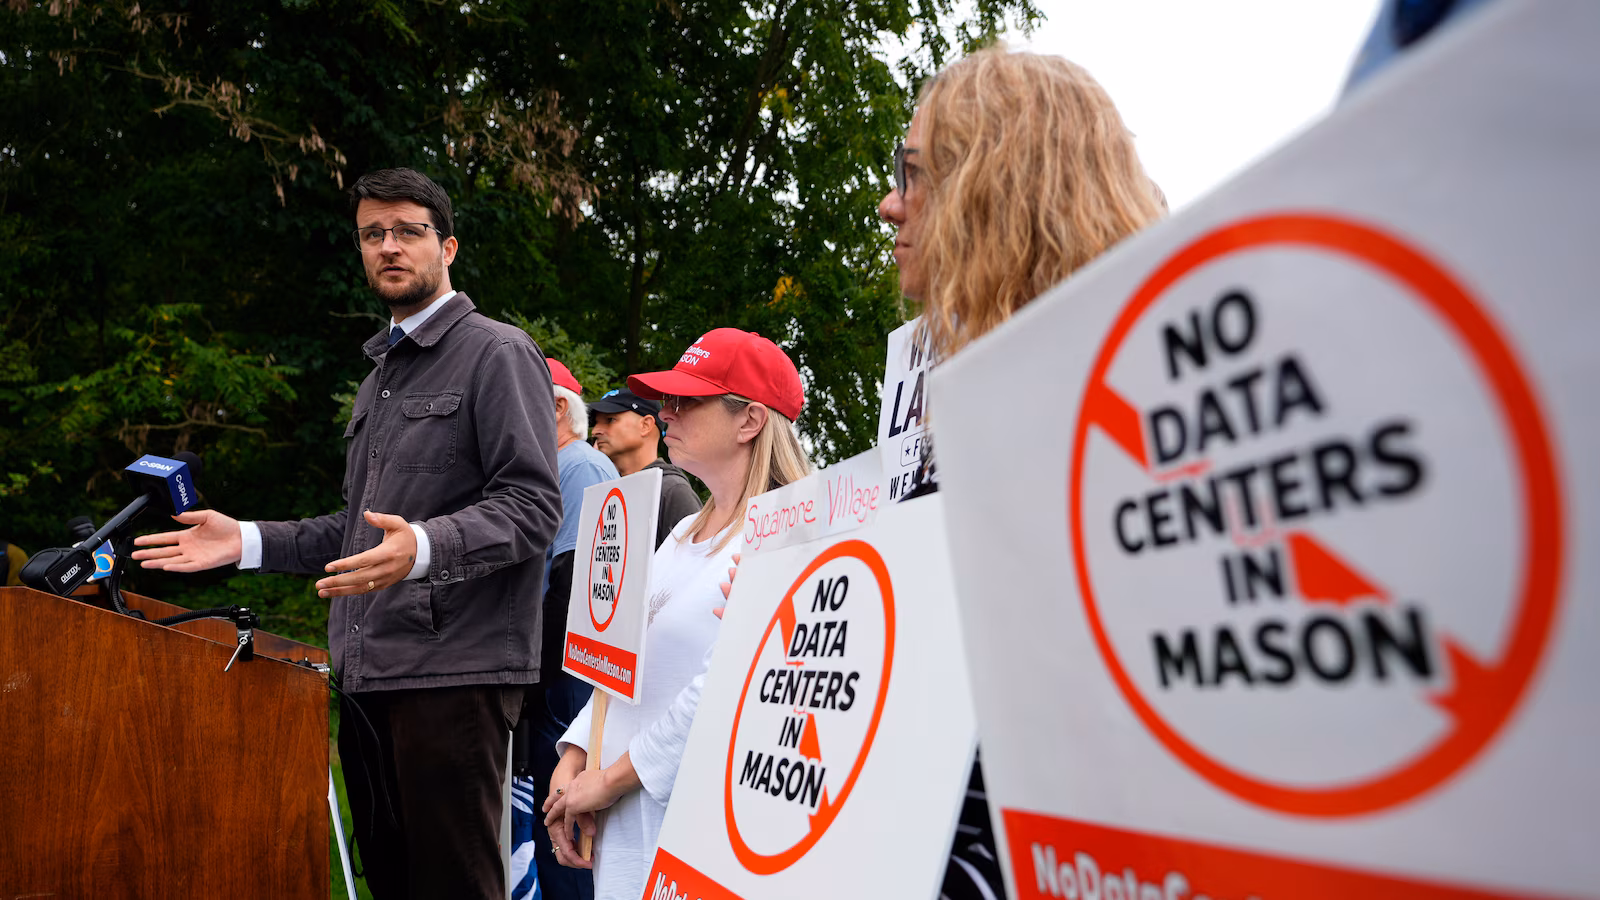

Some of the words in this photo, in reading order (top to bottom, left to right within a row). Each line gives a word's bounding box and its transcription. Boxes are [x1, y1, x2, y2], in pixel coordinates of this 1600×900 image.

[1161, 287, 1257, 379] NO
[1147, 355, 1325, 465] DATA
[139, 460, 173, 472] C-SPAN
[175, 474, 190, 507] C-SPAN
[1114, 420, 1427, 555] CENTERS
[607, 503, 617, 520] NO
[745, 499, 816, 550] Sycamore
[827, 474, 880, 526] Village
[602, 524, 617, 541] DATA
[595, 545, 621, 563] CENTERS
[602, 566, 609, 580] IN
[1220, 547, 1288, 606] IN
[592, 583, 616, 602] MASON
[811, 575, 849, 612] NO
[789, 620, 848, 658] DATA
[1152, 605, 1436, 690] MASON
[759, 669, 860, 711] CENTERS
[778, 716, 804, 748] IN
[739, 750, 826, 808] MASON
